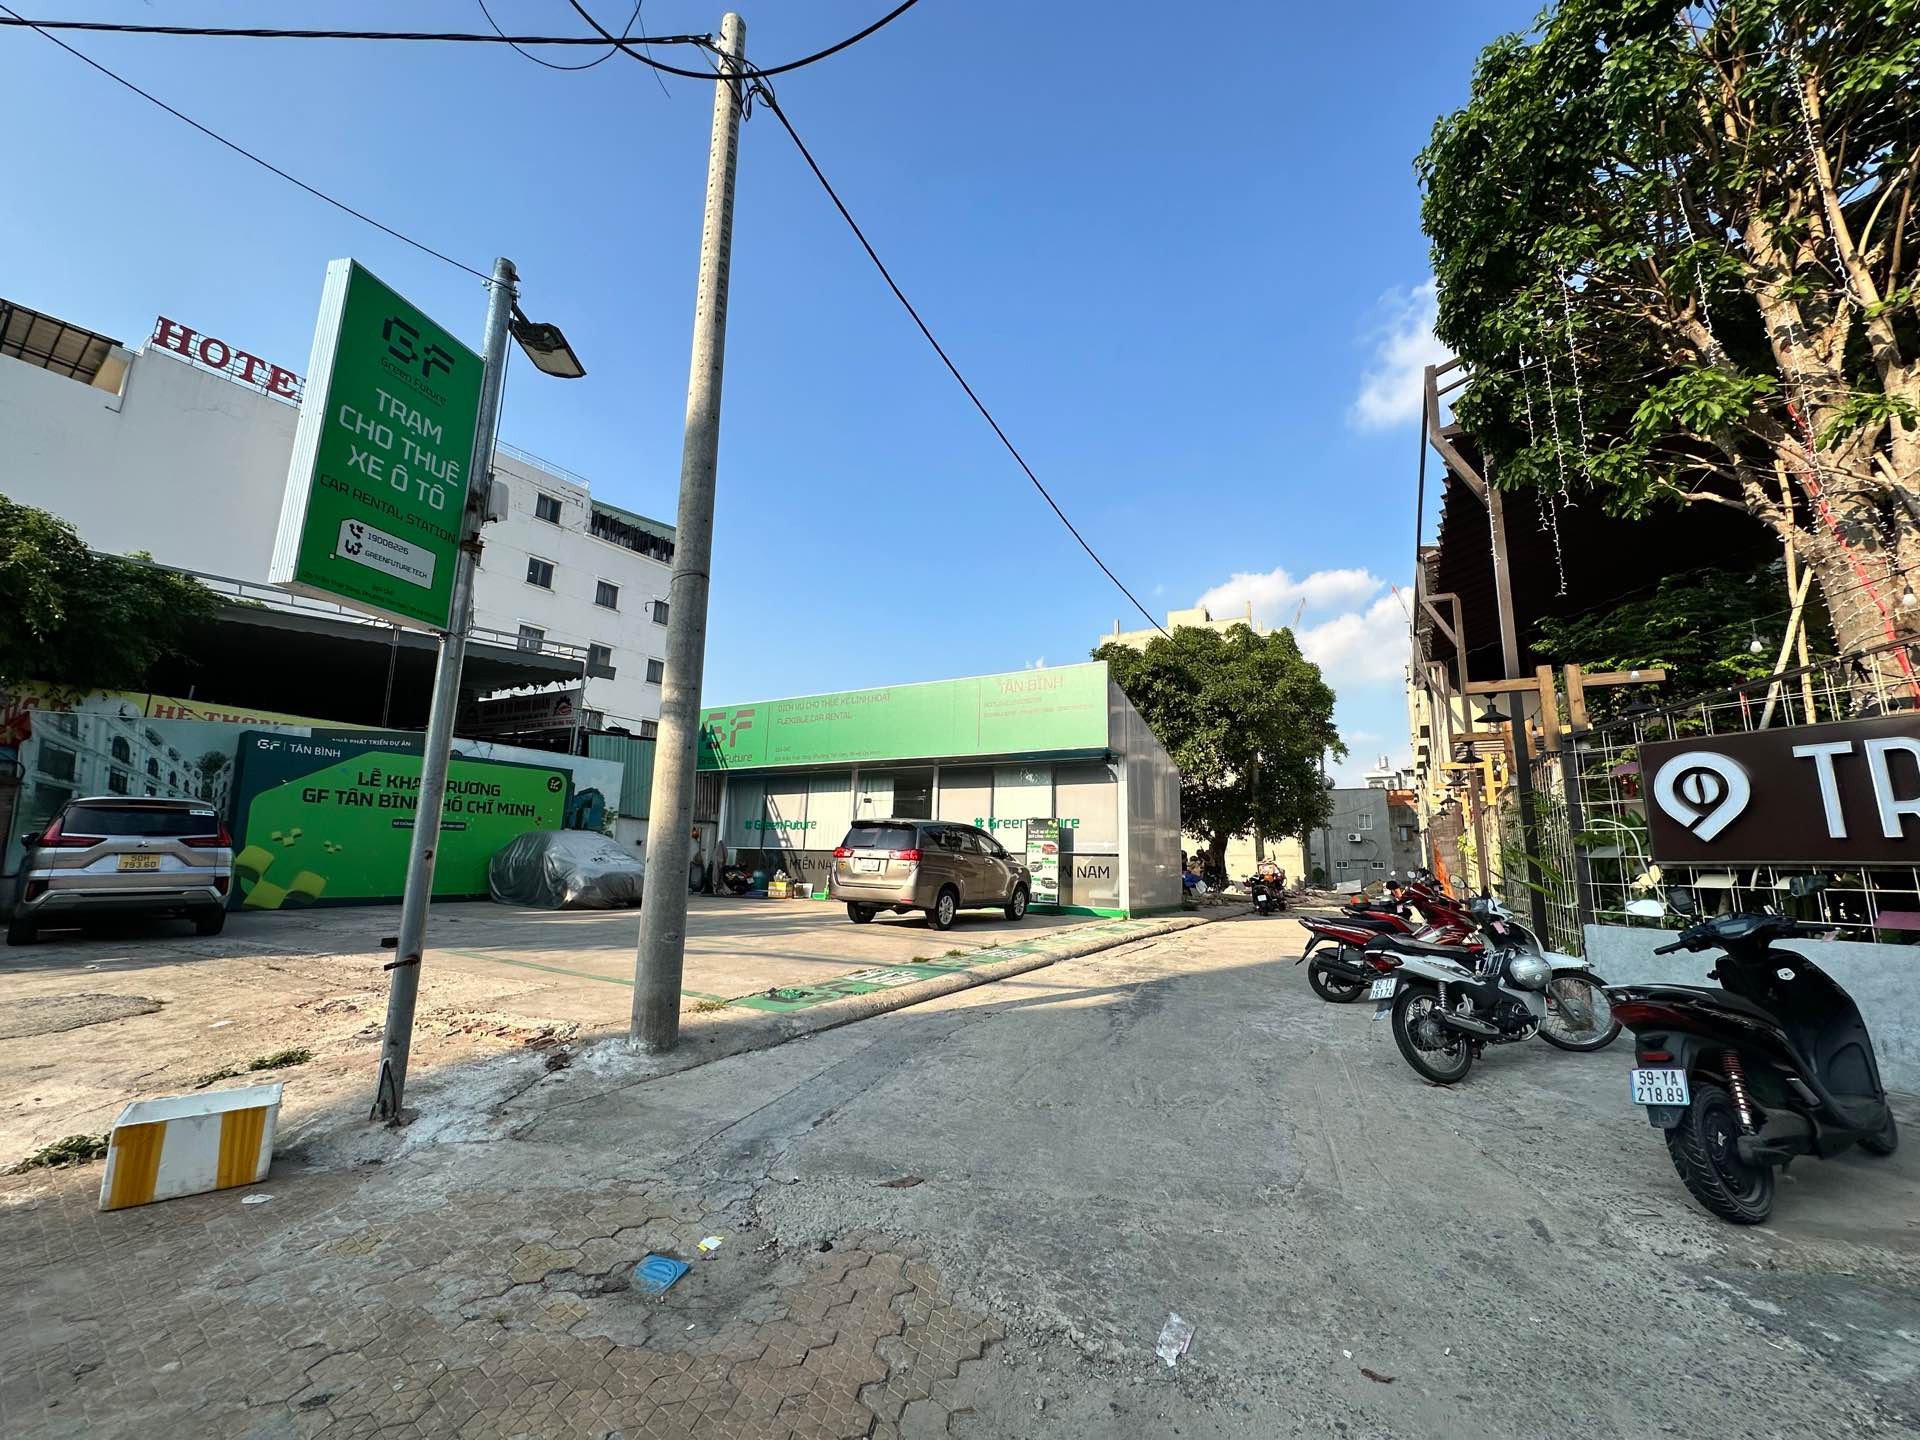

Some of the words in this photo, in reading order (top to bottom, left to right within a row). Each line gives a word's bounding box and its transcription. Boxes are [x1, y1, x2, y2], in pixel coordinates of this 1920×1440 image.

[152, 315, 306, 403] HOTE
[380, 356, 413, 385] Green
[413, 377, 447, 404] Future
[375, 387, 443, 445] TRẠM
[339, 404, 393, 450] CHO
[401, 437, 460, 487] THUÊ
[347, 445, 385, 481] XE
[390, 463, 409, 492] Ô
[416, 479, 445, 511] TÔ
[320, 473, 350, 497] CAR
[352, 487, 404, 521] RENTAL
[407, 513, 457, 546] STATION
[289, 743, 312, 755] TÂN
[314, 746, 341, 758] BÌNH
[725, 753, 752, 763] Future
[357, 767, 381, 787] LỄ
[386, 774, 421, 790] KHA
[446, 780, 501, 797] RƯƠNG
[303, 788, 329, 803] GF
[335, 787, 374, 807] TÂN
[497, 802, 536, 817] MINH
[818, 859, 833, 871] NA
[1077, 865, 1110, 879] NAM
[1638, 1070, 1679, 1086] 59-YA
[1637, 1087, 1684, 1103] 218.89
